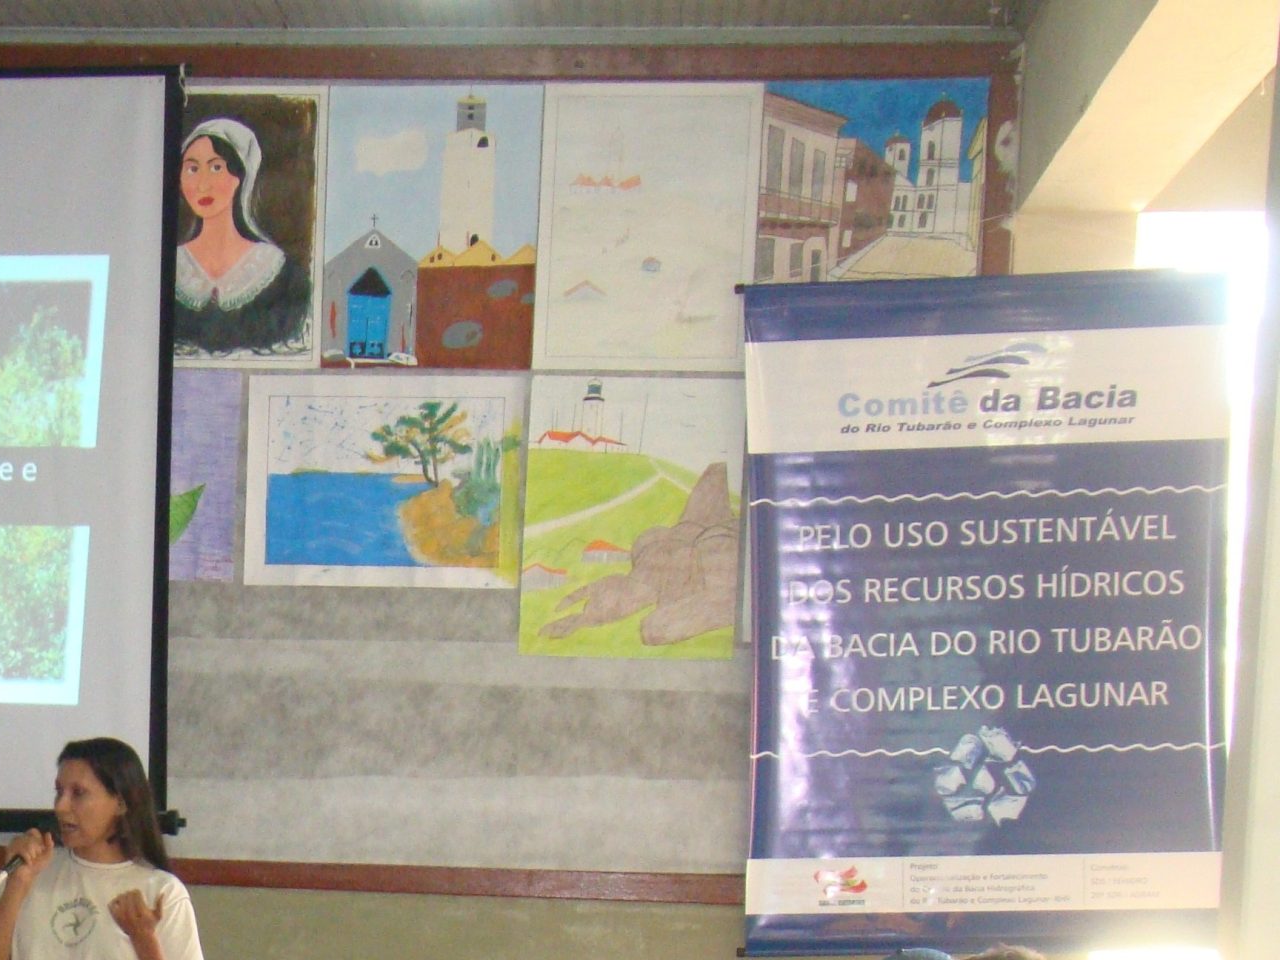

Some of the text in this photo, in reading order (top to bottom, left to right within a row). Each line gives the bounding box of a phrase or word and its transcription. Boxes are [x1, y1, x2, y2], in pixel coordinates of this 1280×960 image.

[838, 385, 1138, 417] Comitê da Bacia
[840, 415, 1136, 434] do Rio Tubarão e Complexo Lagunar
[22, 463, 37, 481] e
[799, 508, 1177, 549] PELO USO SUSTENTÁVEL
[789, 564, 1185, 604] DOS RECURSOS HÍDRICOS
[771, 619, 1203, 660] DA BACIA DO RIO TUBARÃO
[830, 685, 1005, 713] COMPLEXO
[1017, 681, 1169, 709] LAGUNAR
